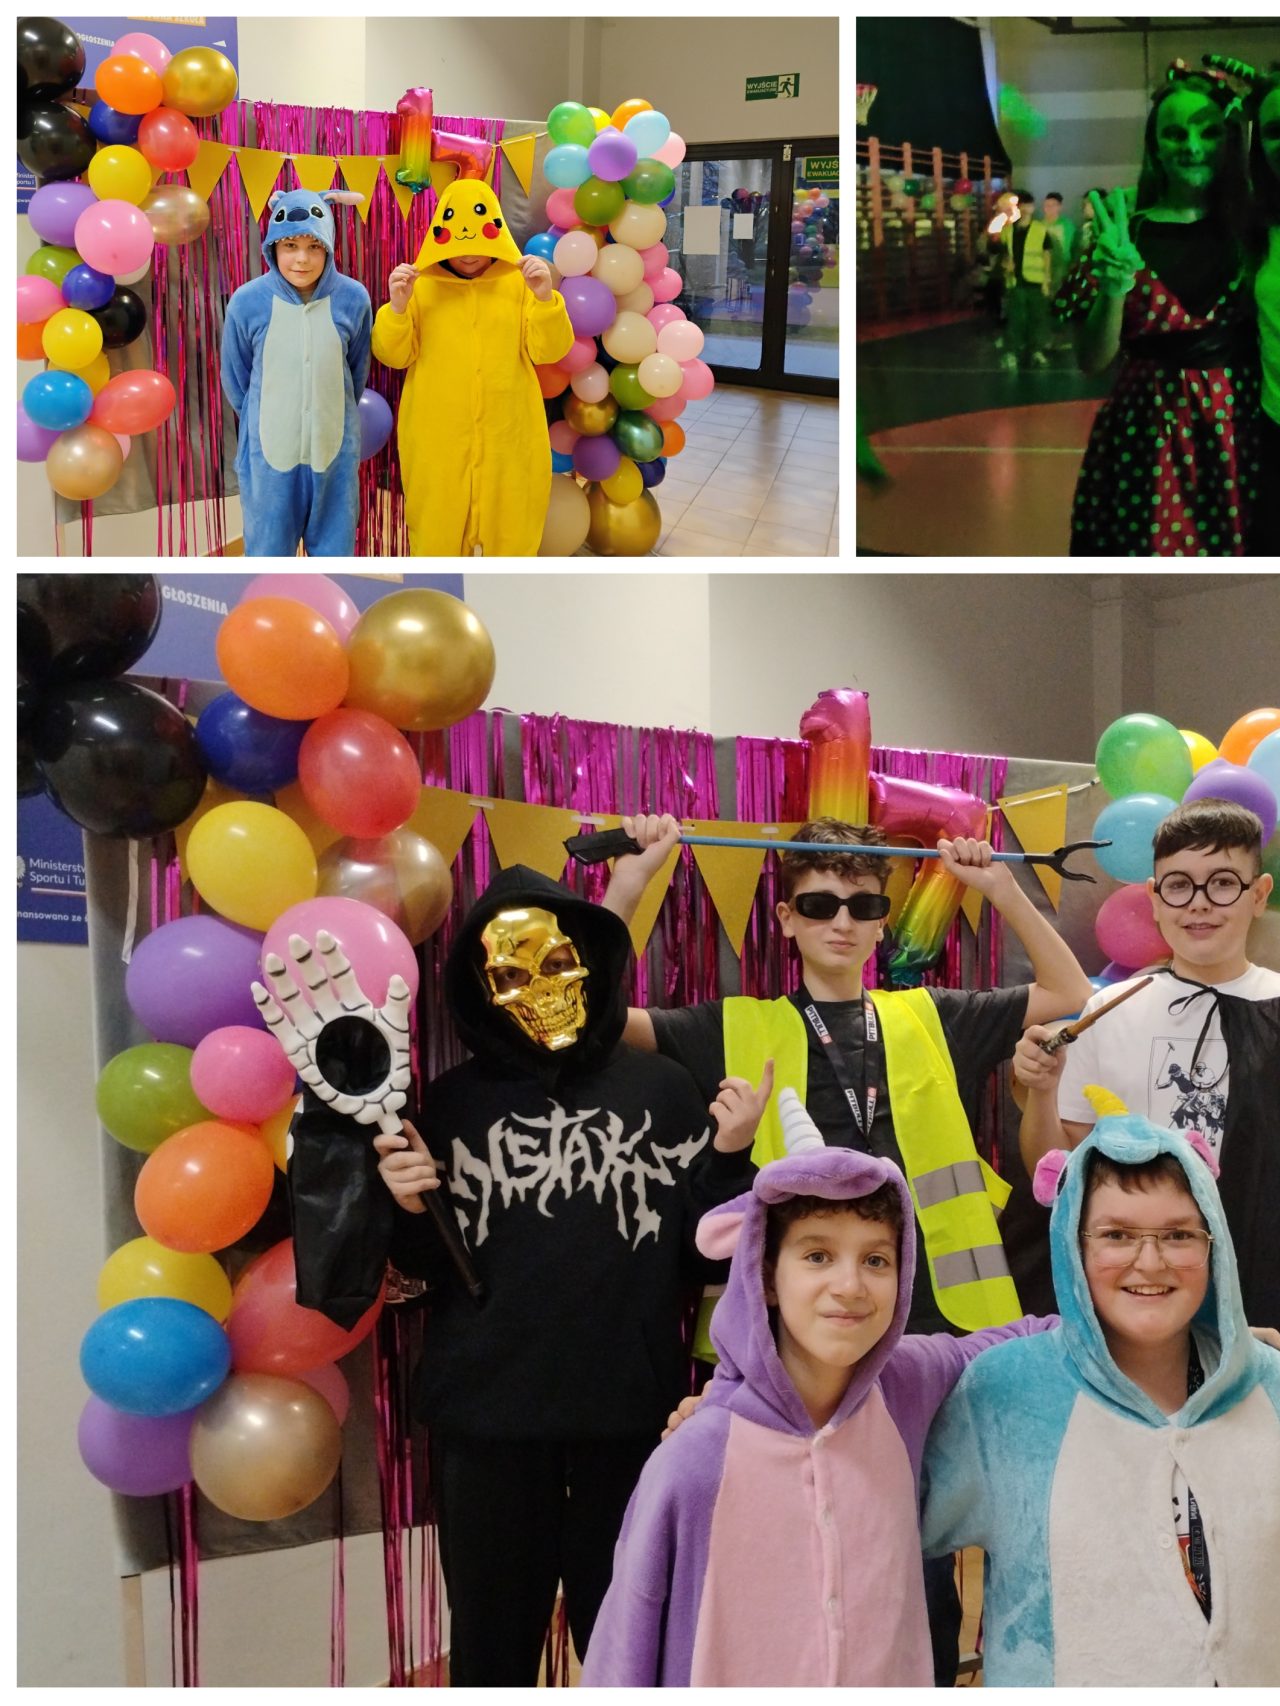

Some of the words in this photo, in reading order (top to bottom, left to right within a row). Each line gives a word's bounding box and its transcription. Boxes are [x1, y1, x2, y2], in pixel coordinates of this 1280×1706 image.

[747, 81, 777, 89] WYJŚCIE
[30, 871, 65, 884] Sportu
[71, 914, 82, 922] ze
[806, 1005, 828, 1036] PITBULL
[867, 1011, 877, 1041] PITBULL
